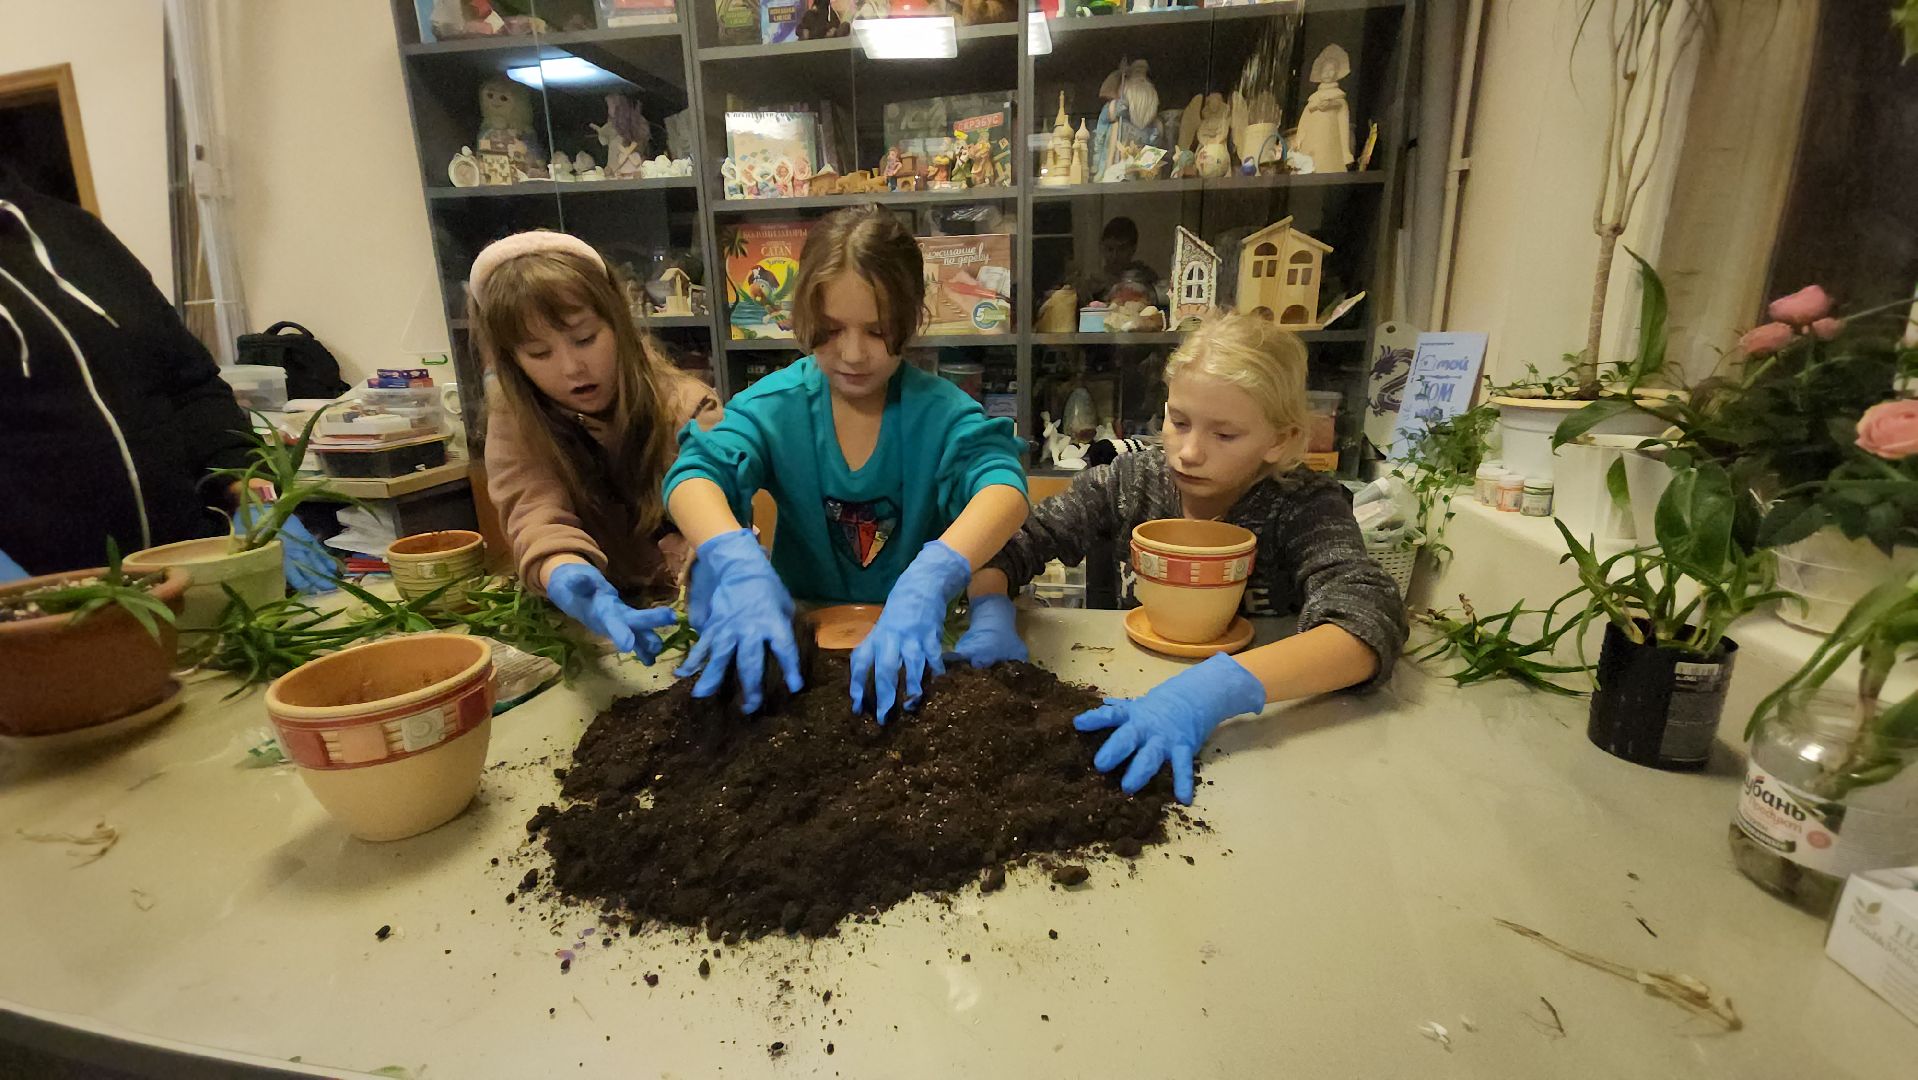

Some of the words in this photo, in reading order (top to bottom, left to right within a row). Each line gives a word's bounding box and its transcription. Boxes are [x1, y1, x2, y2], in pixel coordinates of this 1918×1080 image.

[761, 245, 792, 257] CATAN
[975, 307, 985, 321] 5
[1744, 774, 1806, 821] убань
